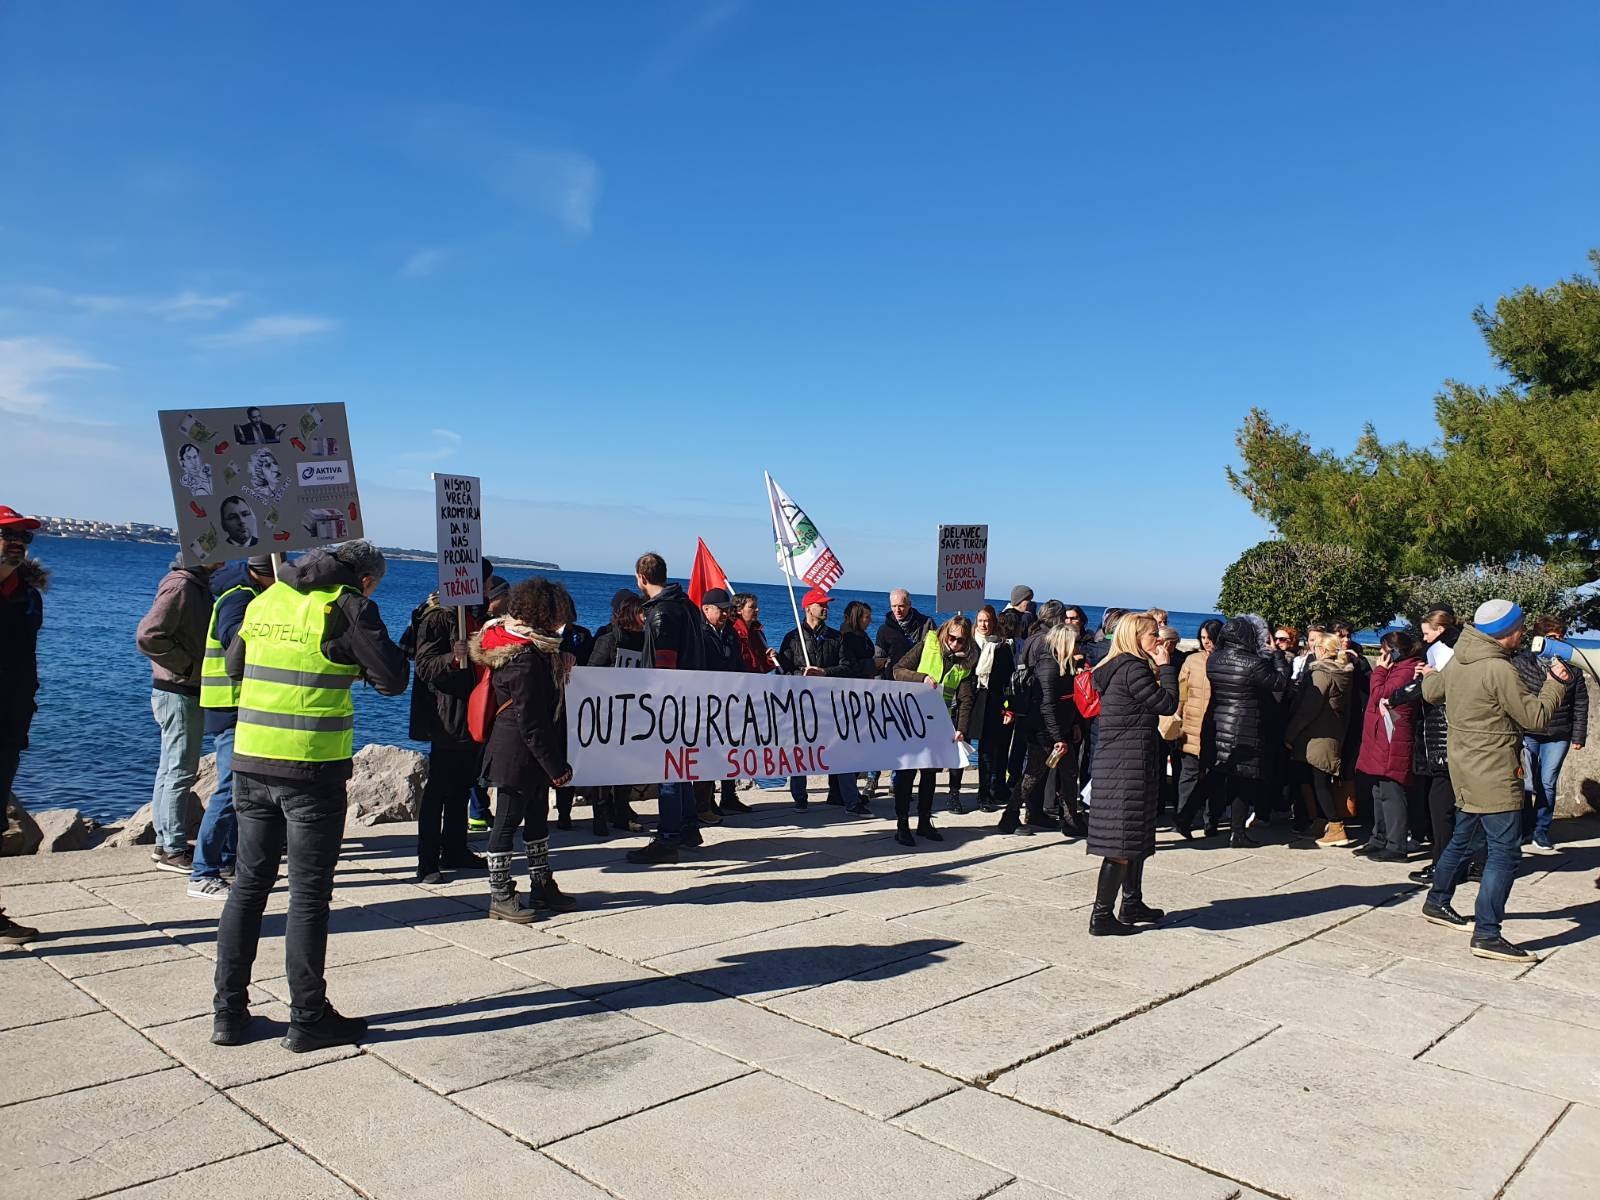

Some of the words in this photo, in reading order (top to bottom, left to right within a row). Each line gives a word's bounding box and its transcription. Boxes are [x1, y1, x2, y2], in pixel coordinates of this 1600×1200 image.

[315, 466, 342, 475] AKTIVA
[444, 478, 471, 492] NISMO
[450, 522, 460, 534] DA
[462, 522, 470, 534] BI
[944, 526, 981, 539] DELAVEC
[451, 535, 469, 548] NAS
[940, 538, 960, 549] SAVE
[444, 548, 479, 565] PRODALI
[455, 566, 468, 577] NA
[443, 577, 479, 598] TRŽNICI
[577, 688, 819, 748] OUTSOURCAJMO
[664, 746, 700, 781] NE
[726, 745, 830, 778] SOBARIC
